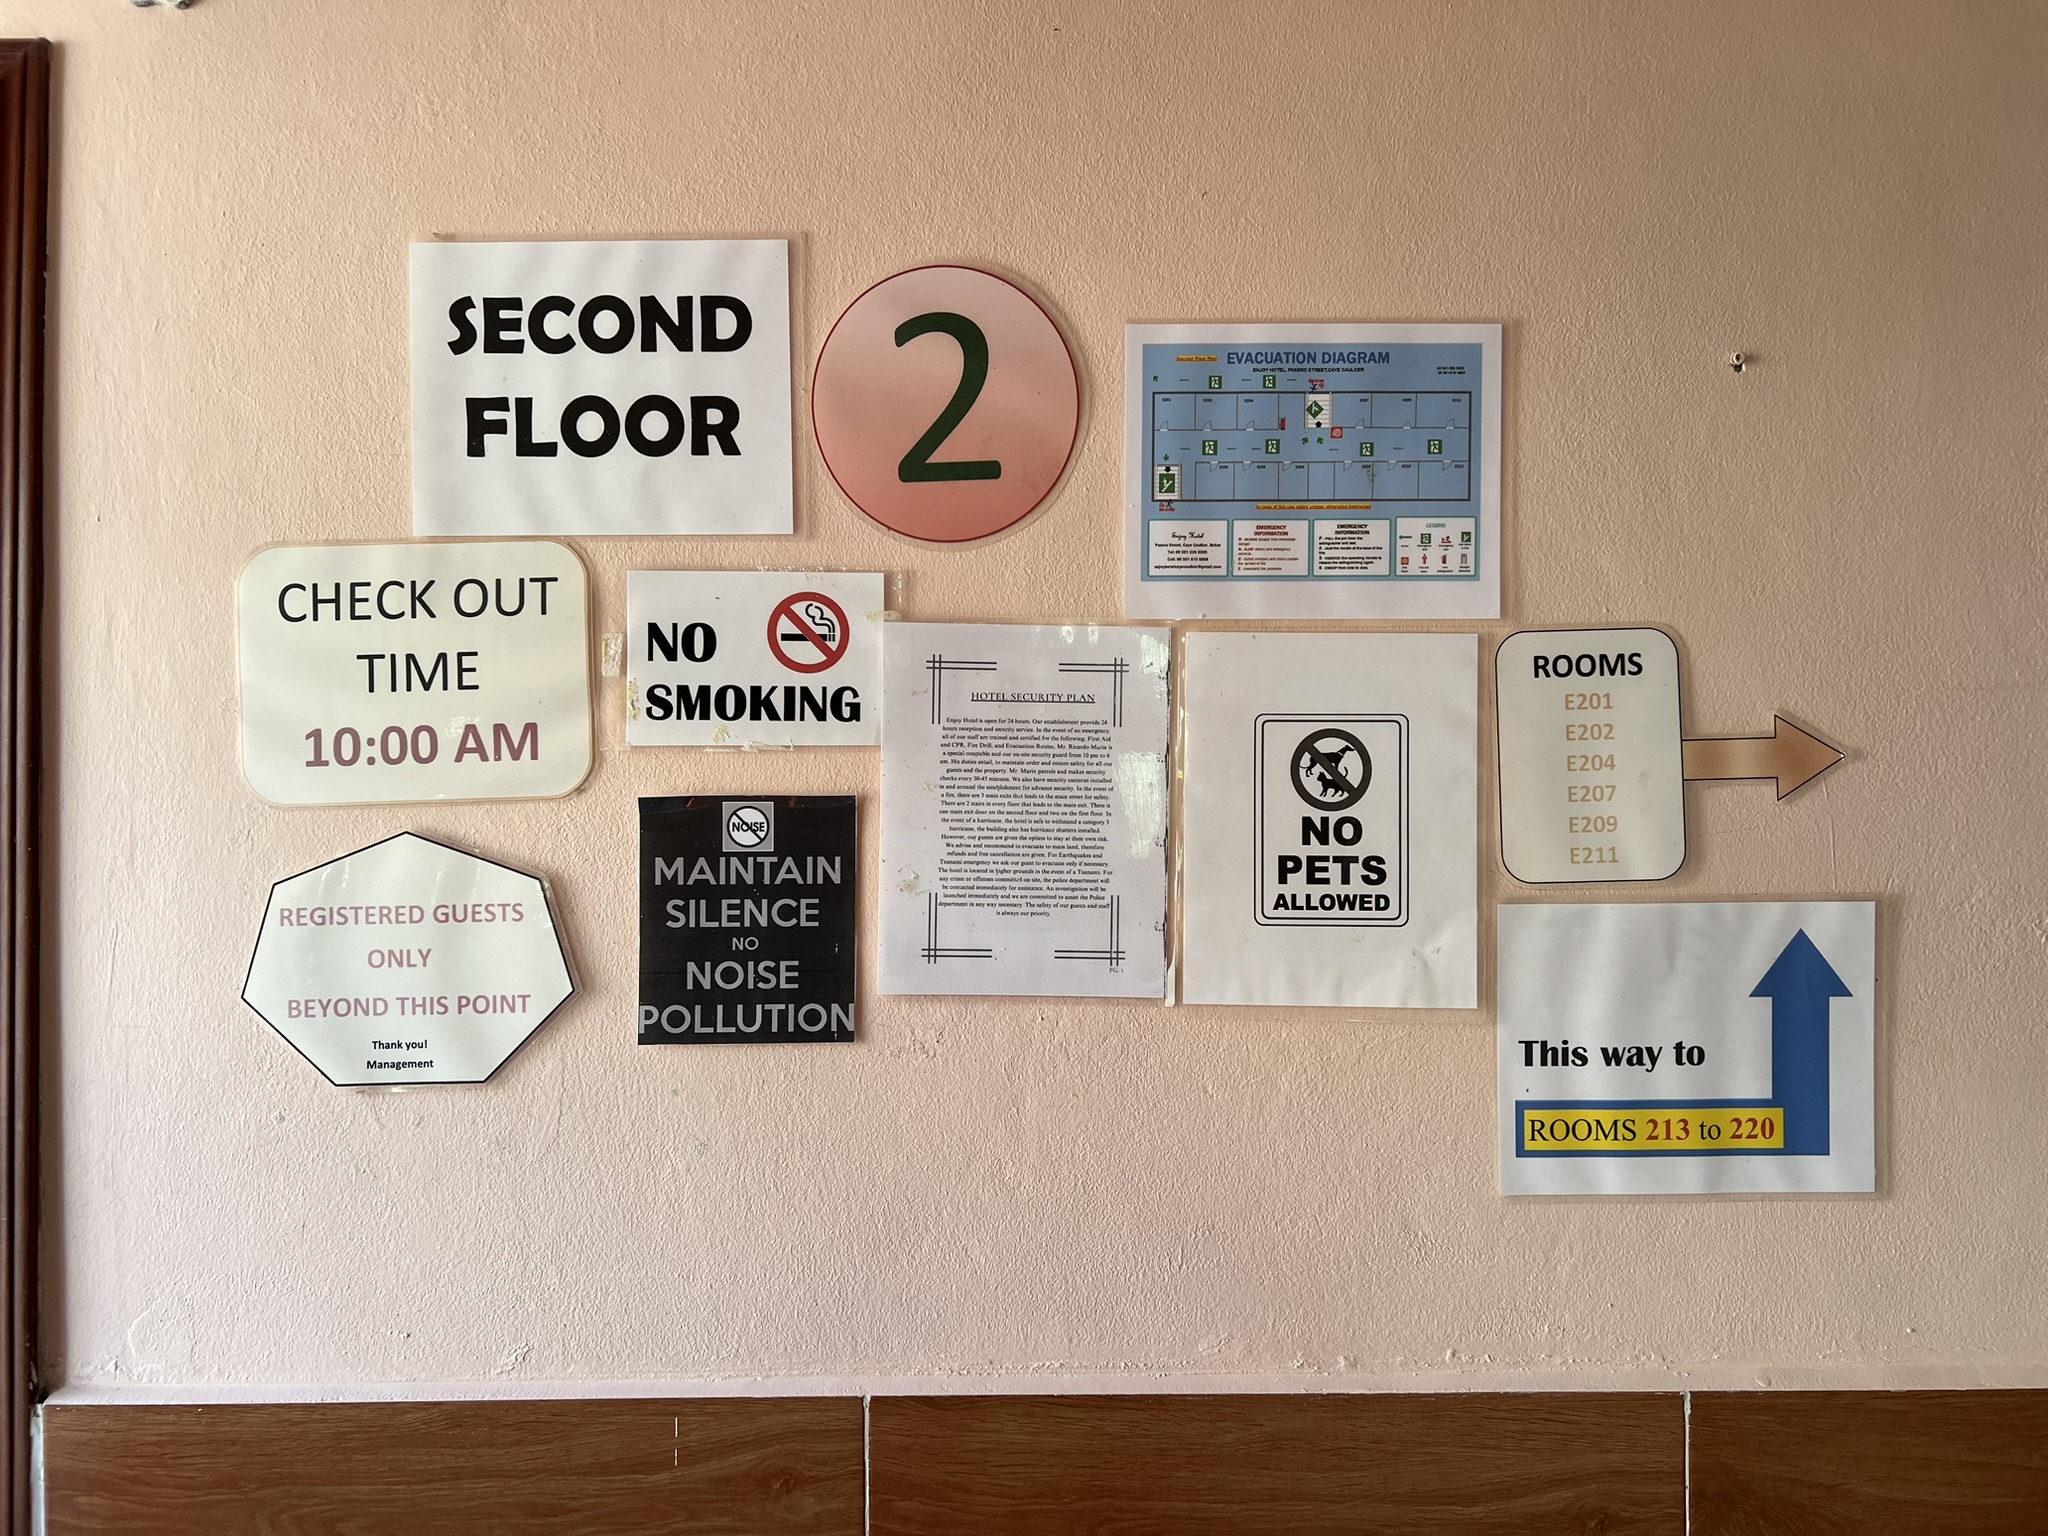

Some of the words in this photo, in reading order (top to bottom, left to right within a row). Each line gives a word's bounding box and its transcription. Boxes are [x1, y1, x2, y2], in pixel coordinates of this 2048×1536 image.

[448, 295, 752, 355] SECOND
[1228, 352, 1316, 364] EVACUATION
[1322, 352, 1389, 364] DIAGRAM
[895, 312, 1001, 483] 2
[466, 395, 741, 457] FLOOR
[279, 580, 436, 622] CHECK
[454, 577, 558, 617] OUT
[648, 623, 716, 662] NO
[357, 652, 479, 693] TIME
[1534, 653, 1642, 678] ROOMS
[646, 684, 860, 722] SMOKING
[971, 692, 1006, 701] HOTEL
[1011, 693, 1063, 701] SECURITY
[1067, 694, 1095, 702] PLAN
[1565, 693, 1613, 710] E201
[306, 725, 438, 767] 10:00
[454, 722, 538, 762] AM
[1566, 724, 1614, 741] E202
[1567, 755, 1615, 771] E204
[1568, 785, 1616, 802] E207
[732, 821, 765, 833] NOISE
[1302, 816, 1362, 846] NO
[1569, 816, 1617, 833] E209
[1571, 847, 1619, 864] E211
[655, 857, 840, 885] MAINTAIN
[1278, 855, 1386, 885] PETS
[281, 906, 424, 926] REGISTERED
[433, 903, 523, 923] GUESTS
[666, 899, 819, 928] SILENCE
[1273, 894, 1390, 911] ALLOWED
[733, 937, 758, 950] NO
[368, 949, 432, 968] ONLY
[687, 961, 798, 989] NOISE
[289, 998, 388, 1018] BEYOND
[396, 996, 448, 1015] THIS
[458, 995, 530, 1014] POINT
[639, 1003, 855, 1033] POLLUTION
[371, 1039, 398, 1050] Thank
[399, 1039, 428, 1052] you!
[1518, 1040, 1588, 1066] This
[1600, 1046, 1662, 1072] way
[1673, 1041, 1705, 1066] to
[367, 1060, 433, 1070] Management
[1529, 1119, 1636, 1141] ROOMS
[1646, 1119, 1689, 1140] 213
[1699, 1121, 1721, 1140] to
[1730, 1117, 1774, 1140] 220
